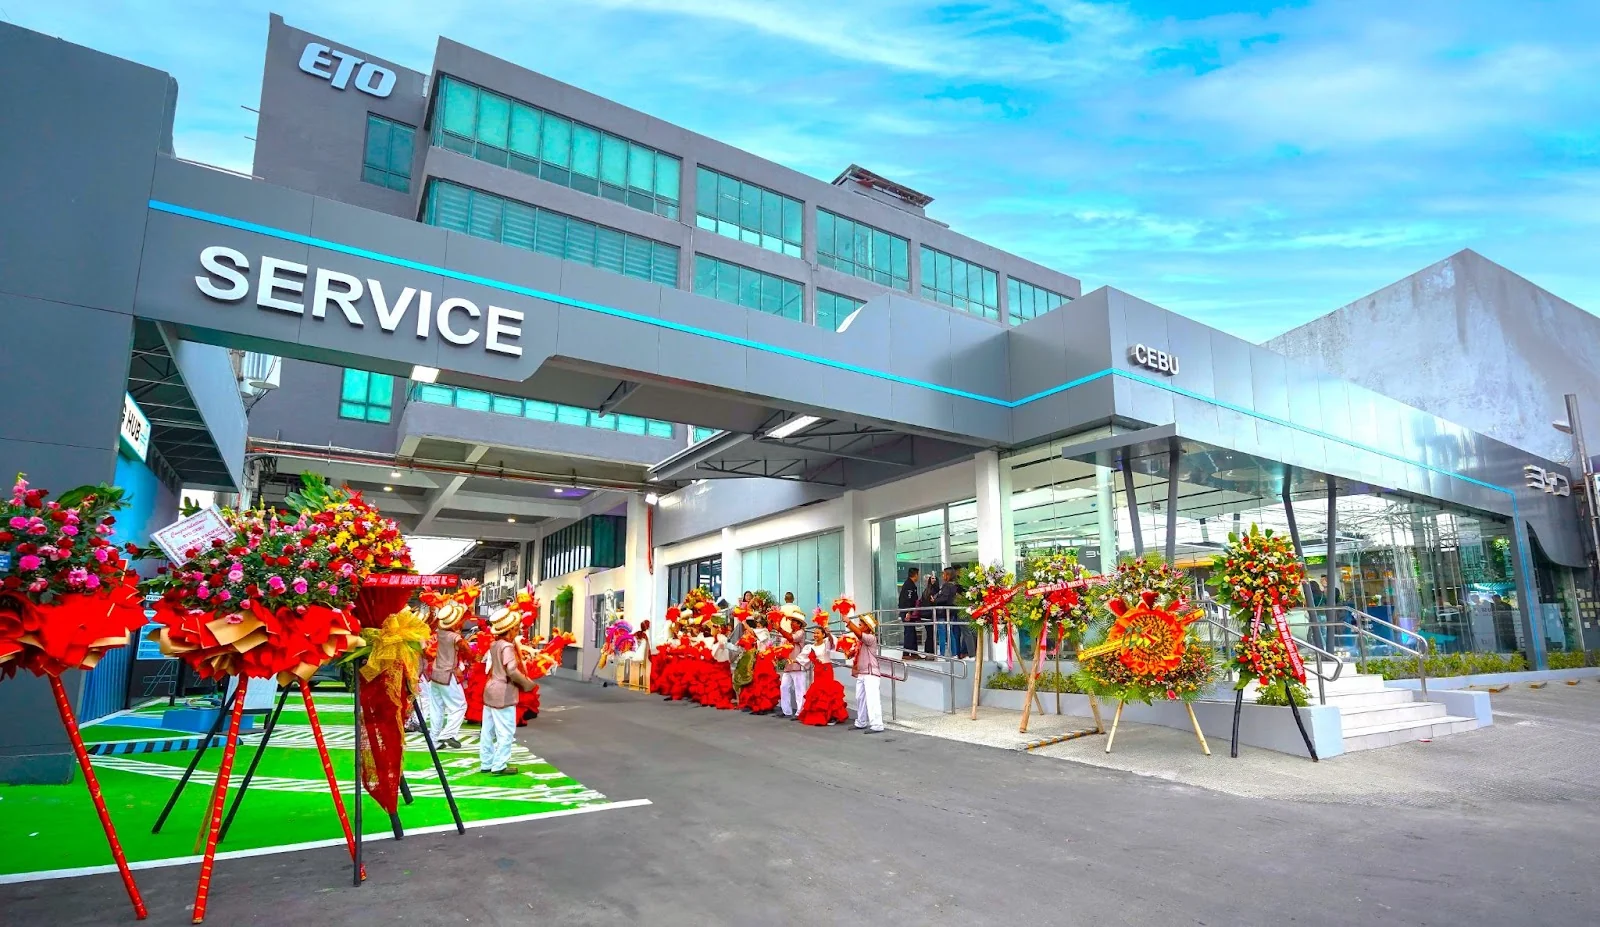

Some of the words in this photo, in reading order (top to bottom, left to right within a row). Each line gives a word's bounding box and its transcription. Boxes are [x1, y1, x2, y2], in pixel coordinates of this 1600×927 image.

[299, 42, 397, 98] ETO
[194, 245, 526, 357] SERVICE
[1135, 343, 1180, 375] CEBU
[126, 410, 141, 441] HUB
[1523, 464, 1571, 497] BYD
